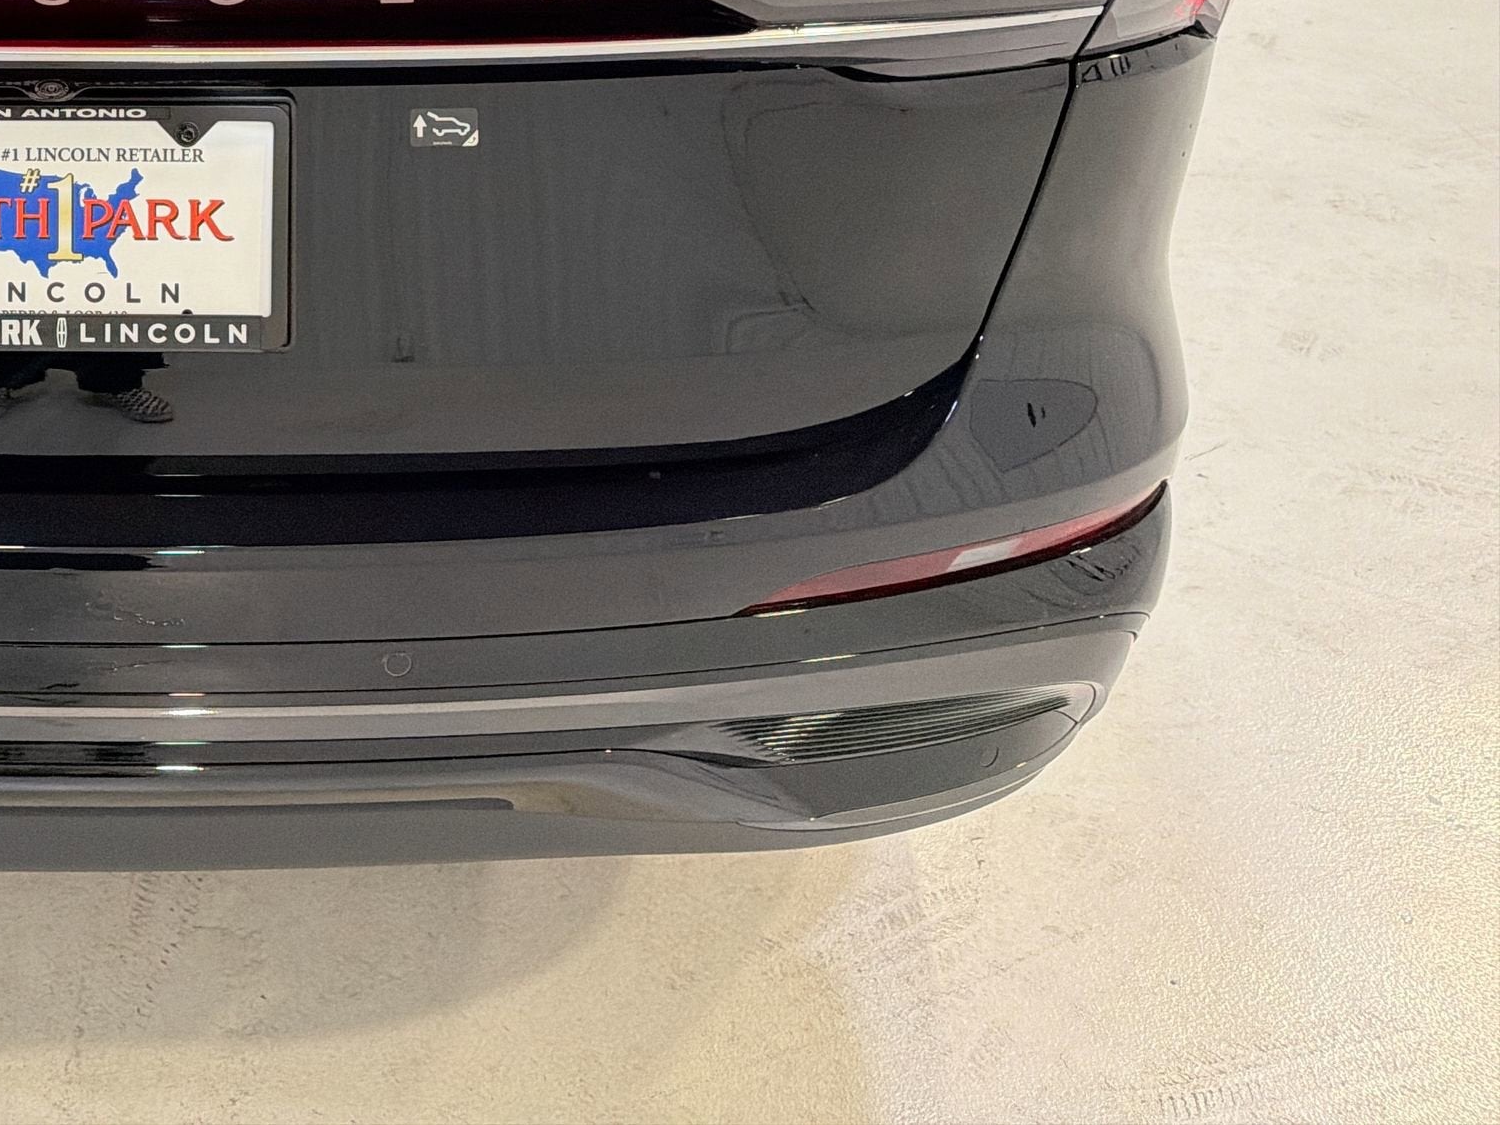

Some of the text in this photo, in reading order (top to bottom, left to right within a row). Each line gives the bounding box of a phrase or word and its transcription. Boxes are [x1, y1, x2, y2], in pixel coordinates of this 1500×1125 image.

[21, 107, 148, 119] ANTONIO
[1, 147, 19, 163] #1
[25, 147, 111, 164] LINCOLN
[116, 146, 206, 164] RETAILER
[81, 197, 235, 242] PARK
[79, 322, 249, 345] LINCOLN
